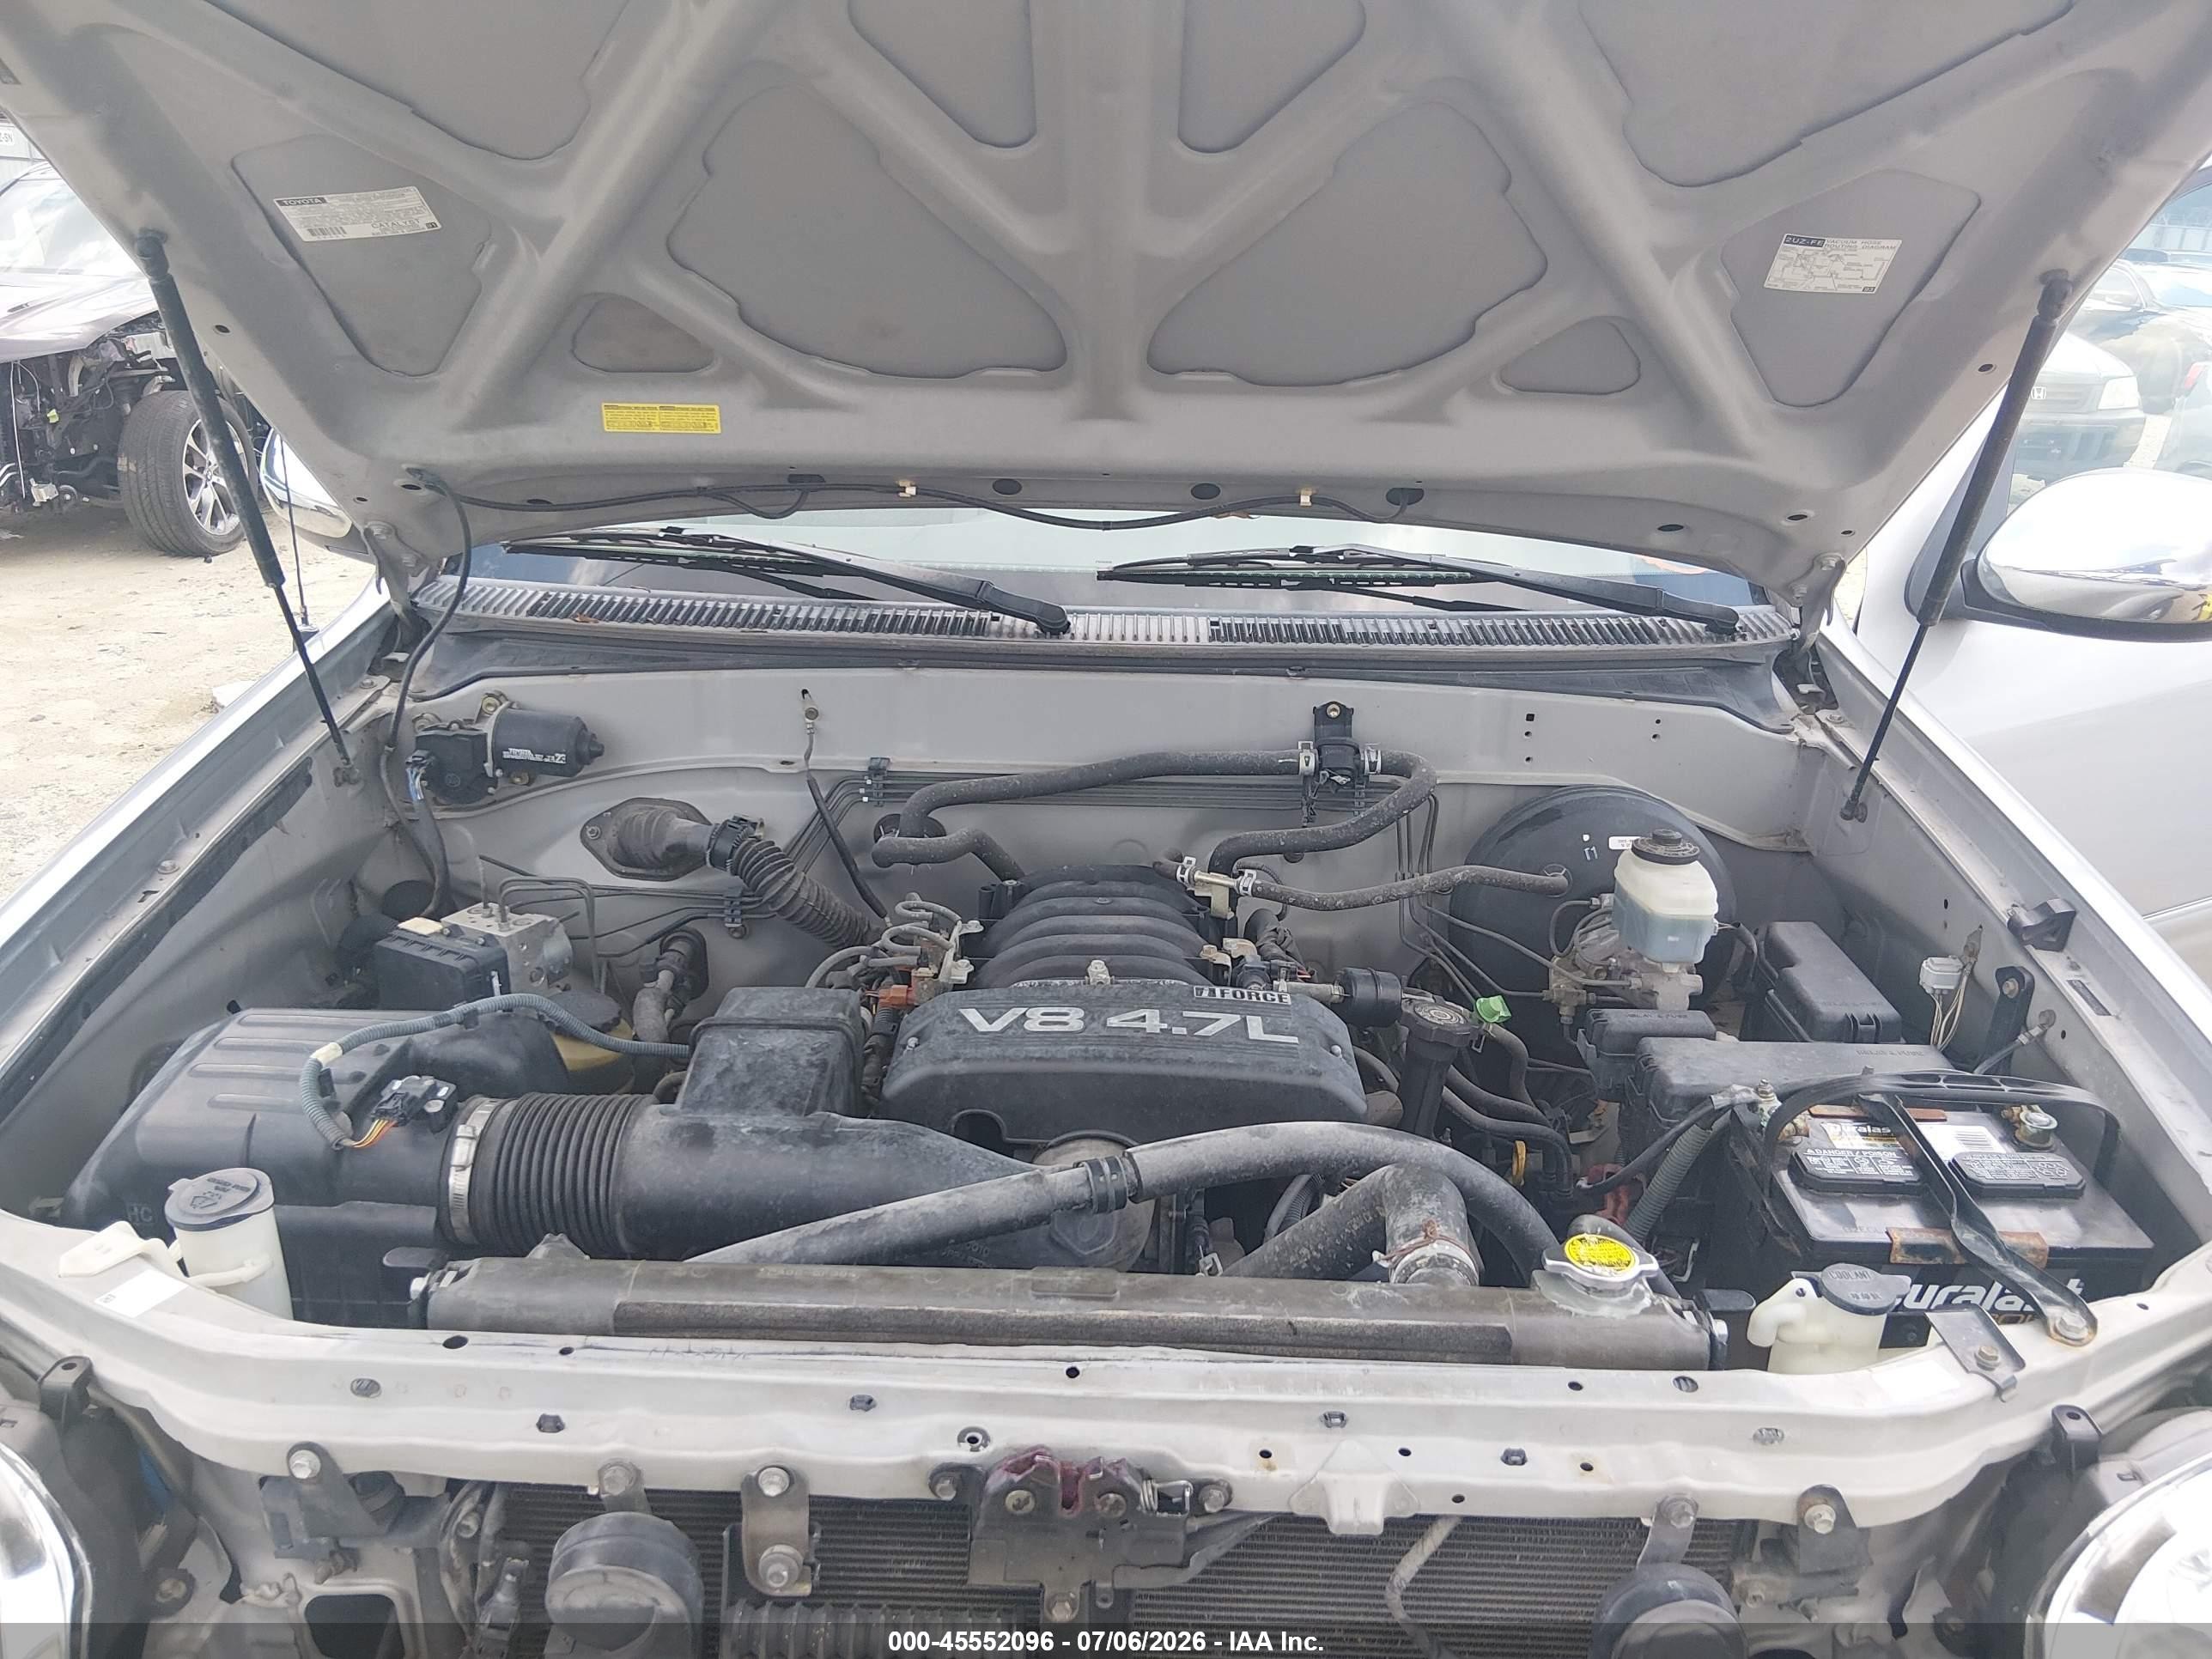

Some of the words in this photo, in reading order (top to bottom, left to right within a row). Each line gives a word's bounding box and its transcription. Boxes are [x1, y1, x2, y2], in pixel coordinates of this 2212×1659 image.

[283, 198, 324, 206] TOYOTA
[371, 218, 420, 229] CATALYST
[1785, 237, 1825, 246] 2UZ-FE
[959, 1006, 1085, 1033] V8
[1106, 1008, 1299, 1045] 4.7L
[1828, 1270, 1871, 1280] COOLANT
